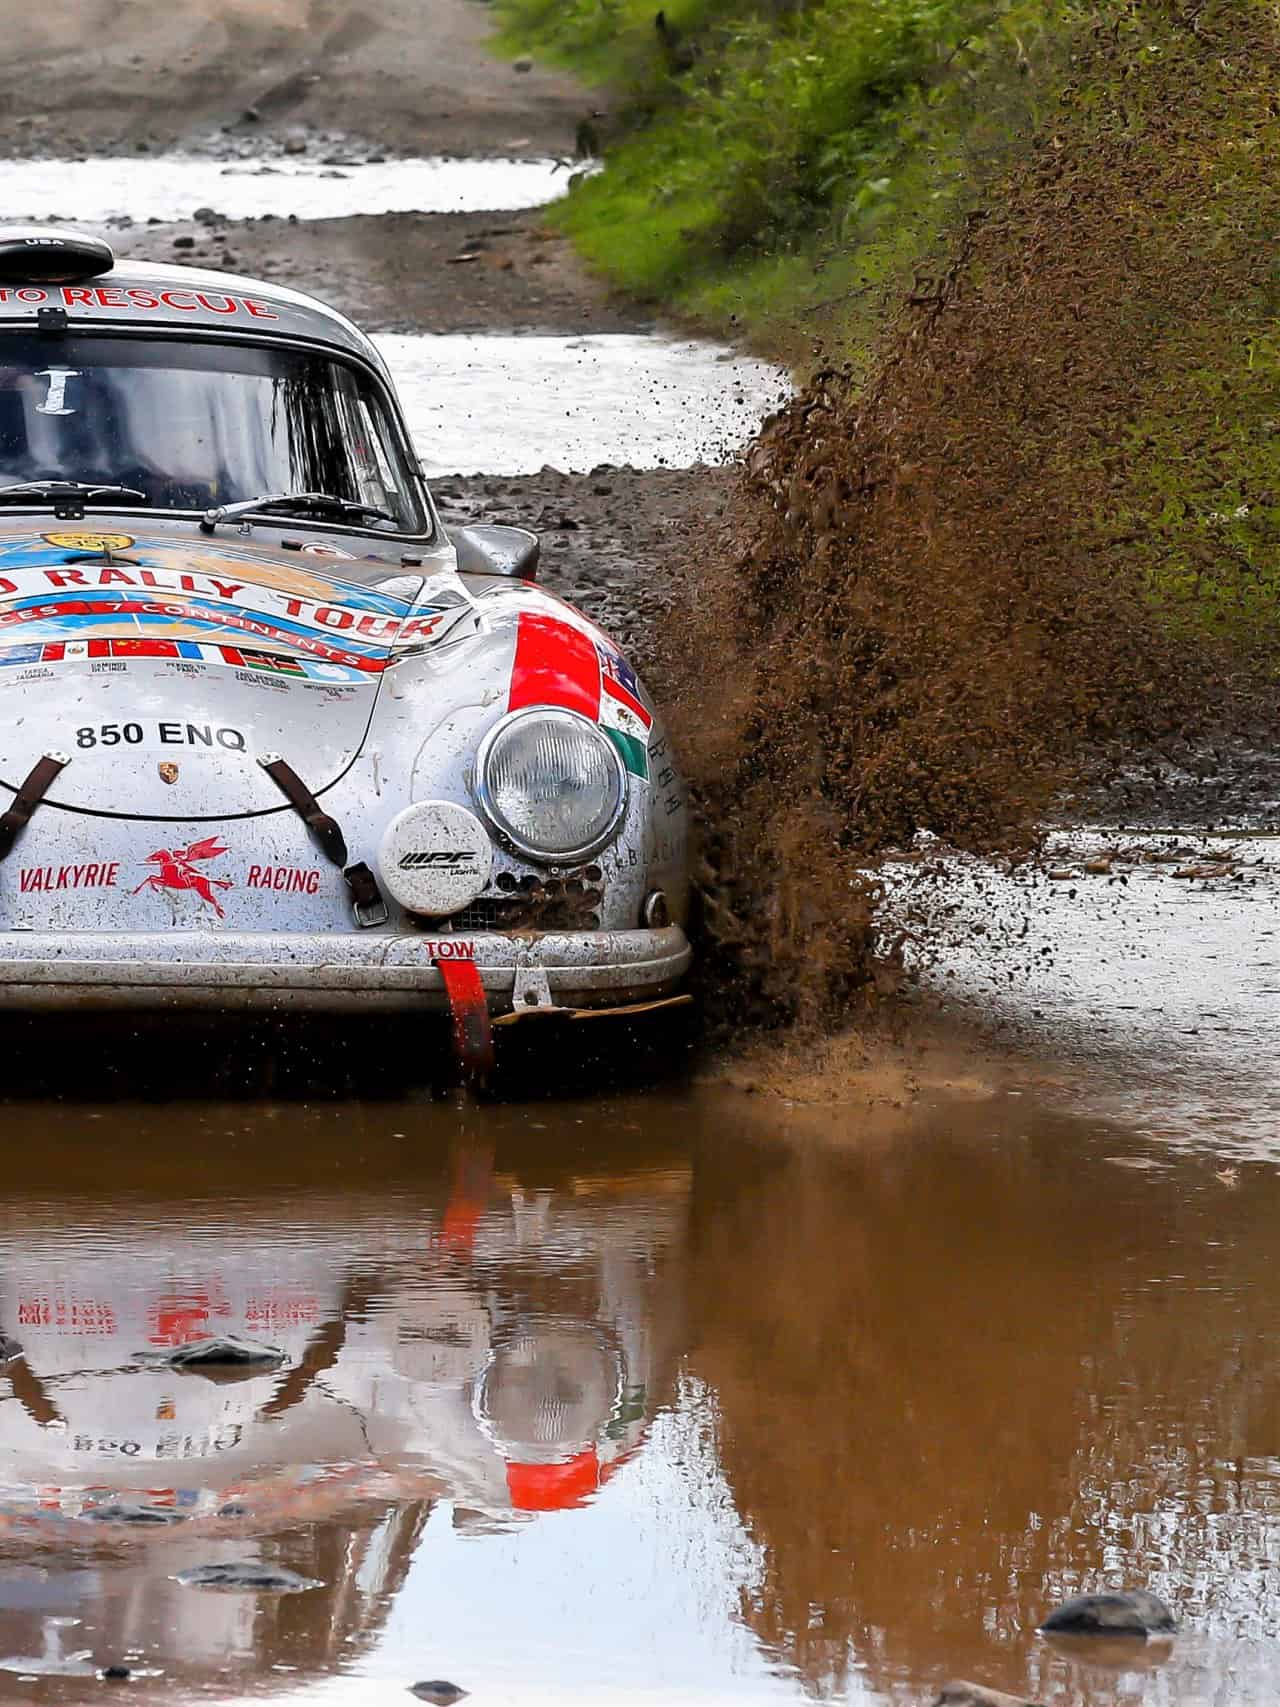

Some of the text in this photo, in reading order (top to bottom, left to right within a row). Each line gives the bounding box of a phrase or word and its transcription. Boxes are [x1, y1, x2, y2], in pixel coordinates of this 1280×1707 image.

[61, 287, 279, 320] RESCUE
[43, 568, 245, 599] RALLY
[275, 594, 445, 640] TOUR
[106, 602, 122, 612] 7
[141, 604, 362, 665] CONTINENTS
[76, 722, 247, 753] 850 ENQ
[19, 862, 320, 895] VALKYRIE RACING
[423, 941, 475, 958] TOW
